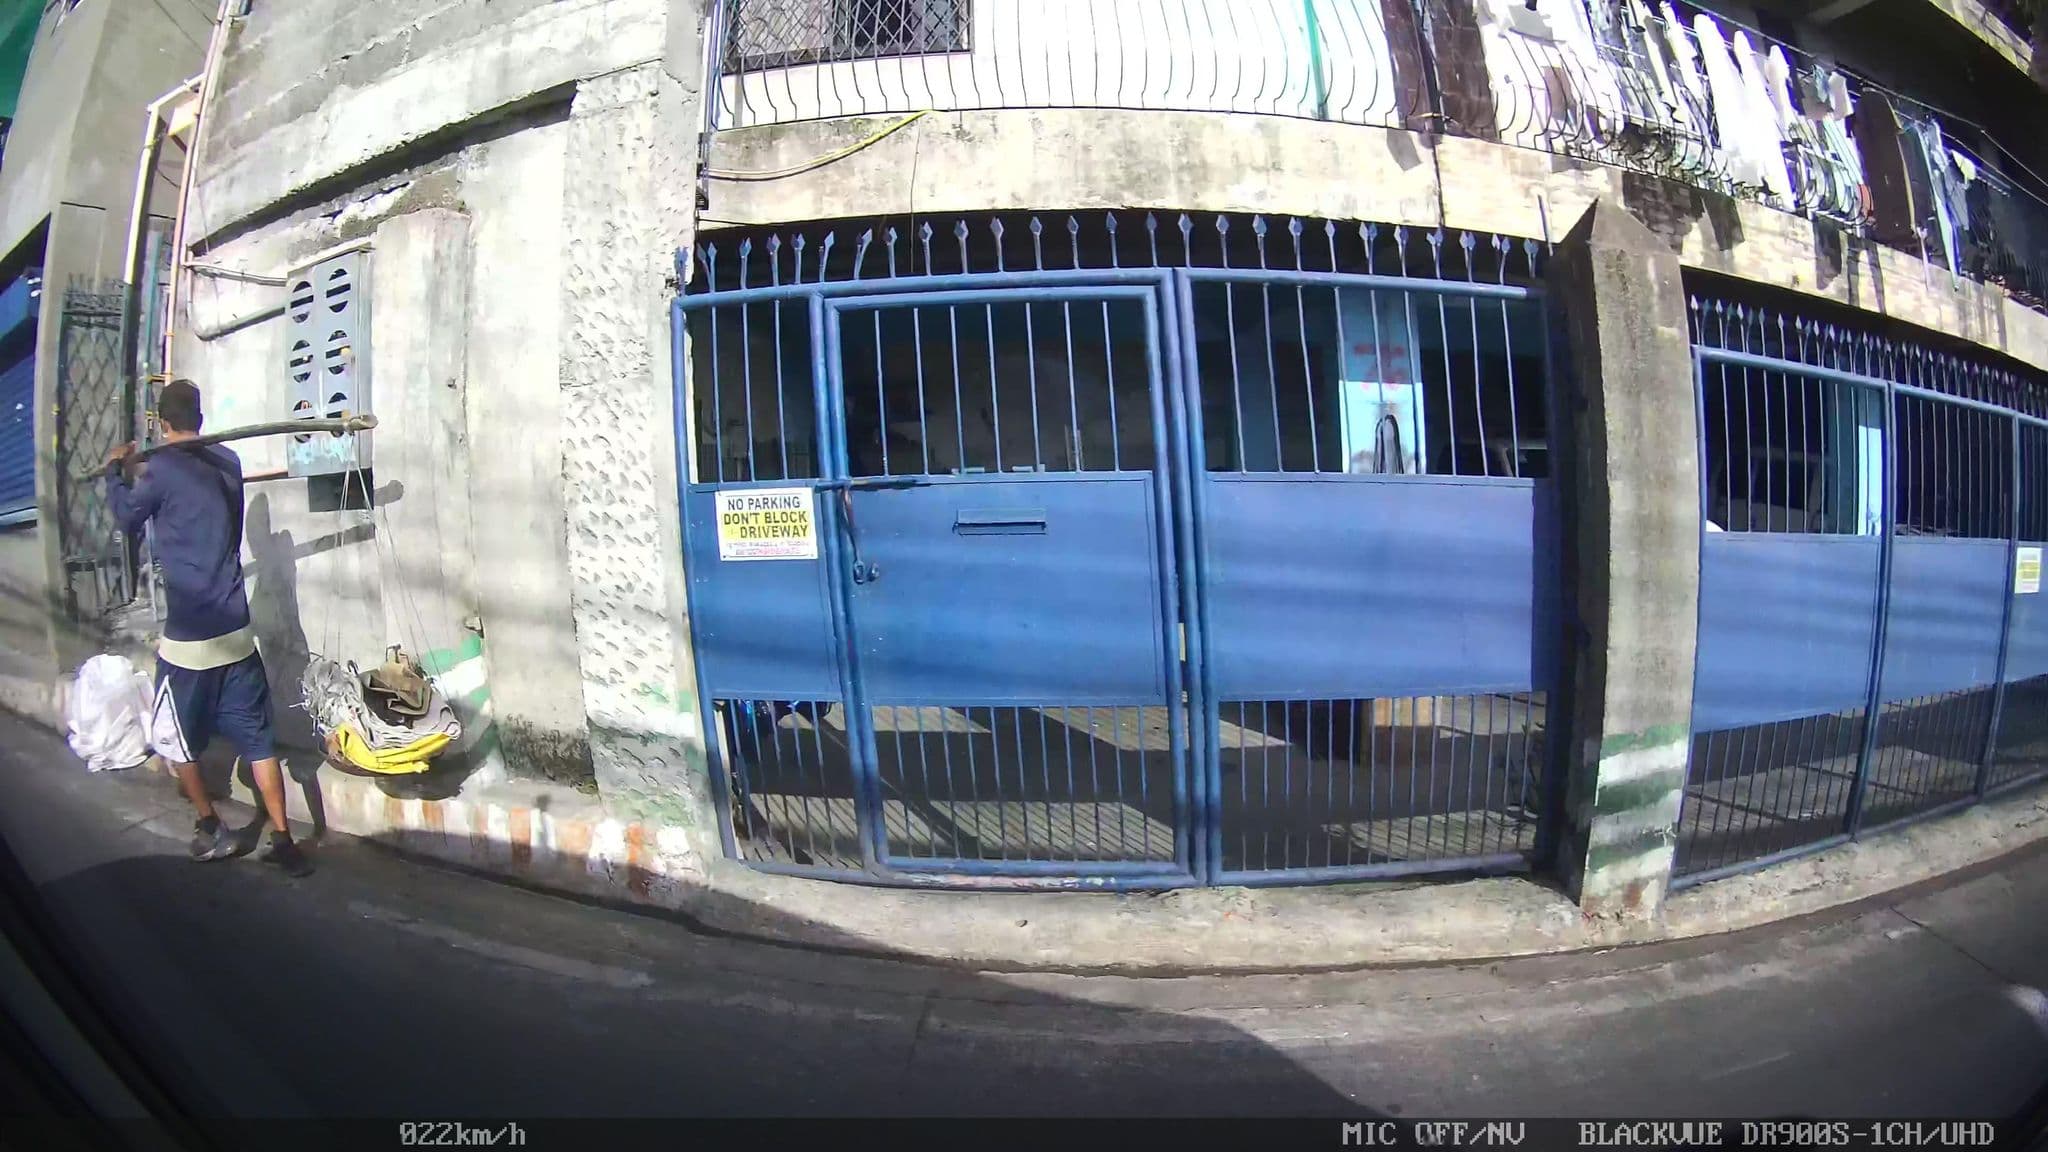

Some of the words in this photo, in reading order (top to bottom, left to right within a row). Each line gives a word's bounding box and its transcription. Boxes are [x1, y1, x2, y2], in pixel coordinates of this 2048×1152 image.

[728, 498, 744, 511] NO
[748, 496, 801, 510] PARKING
[724, 512, 760, 525] DON'T
[764, 511, 808, 524] BLOCK
[740, 525, 808, 538] DRIVEWAY
